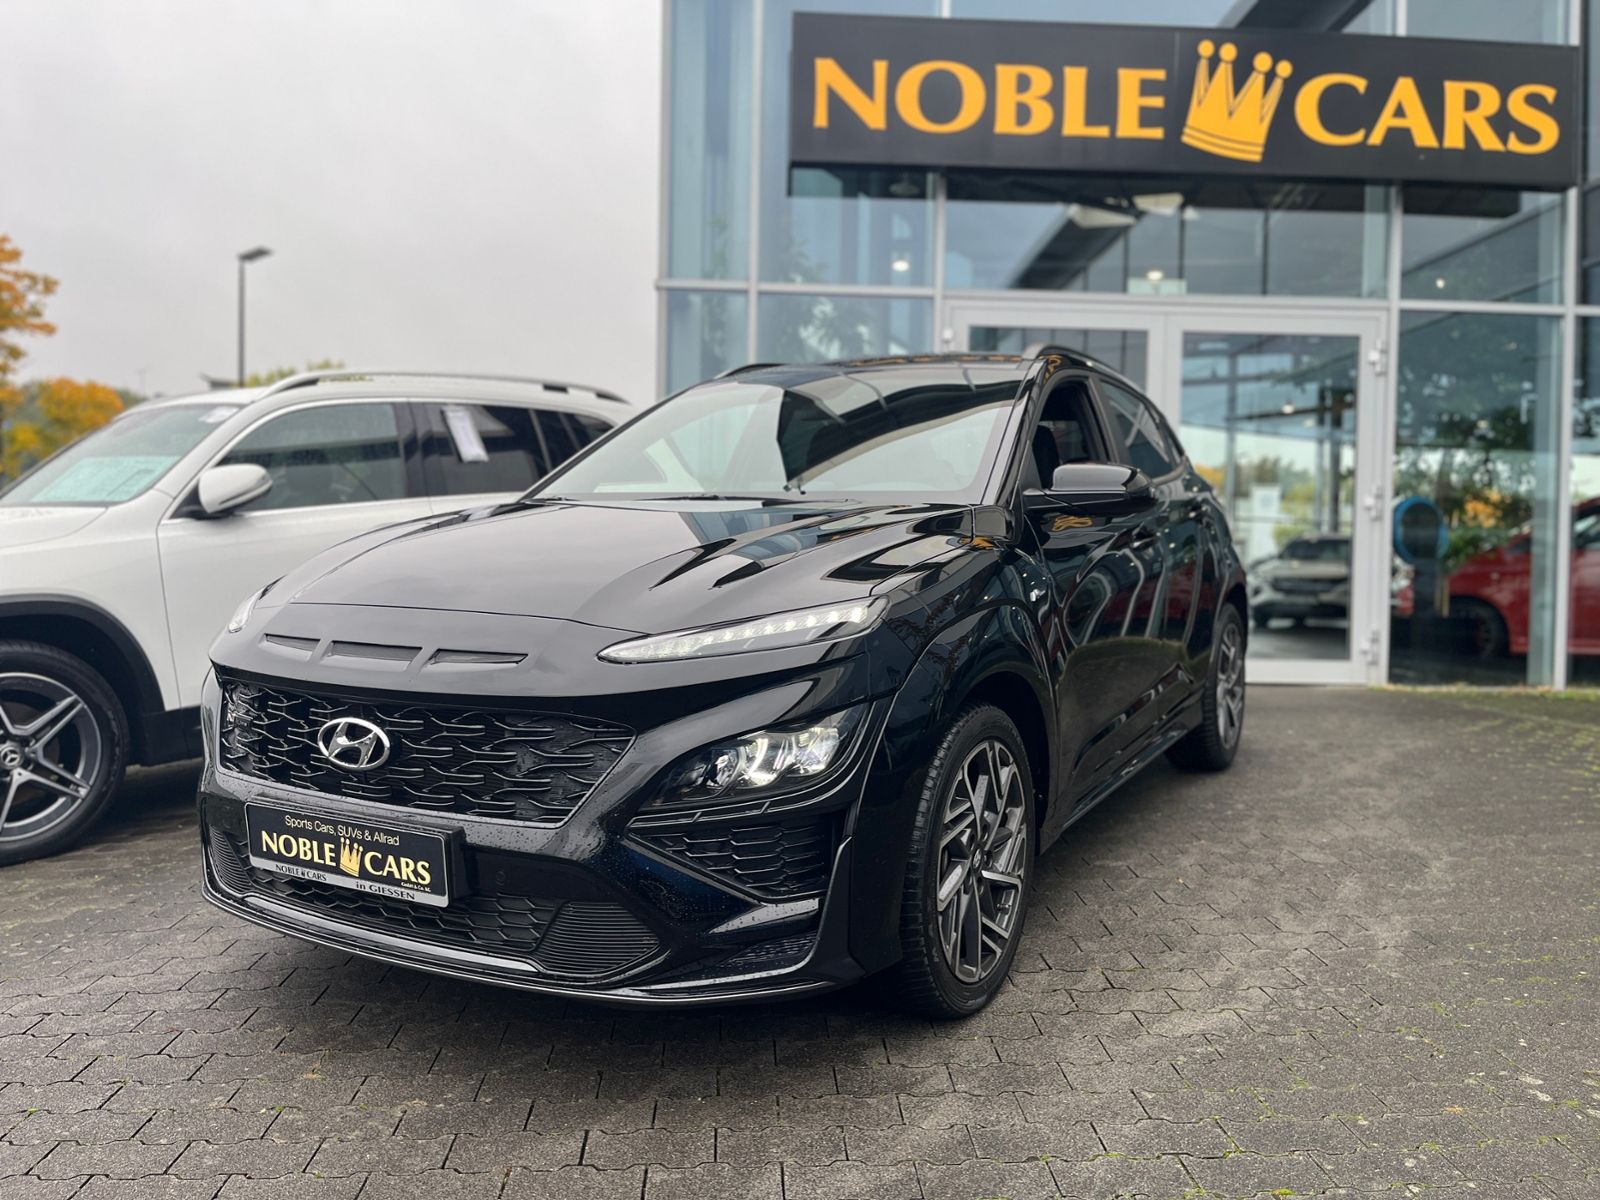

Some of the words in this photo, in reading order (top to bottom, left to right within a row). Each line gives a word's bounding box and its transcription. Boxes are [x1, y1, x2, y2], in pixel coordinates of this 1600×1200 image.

[813, 57, 1167, 140] NOBLE
[1294, 72, 1561, 155] CARS
[285, 814, 313, 830] Sports
[314, 820, 337, 836] Cars,
[338, 824, 363, 840] SUVs
[364, 829, 372, 841] &
[373, 831, 400, 846] Allrad
[261, 830, 337, 867] NOBLE
[364, 851, 431, 885] CARS
[275, 863, 300, 876] NOBLE
[306, 870, 327, 882] CARS
[356, 881, 366, 890] in
[369, 884, 416, 900] GIESSEN
